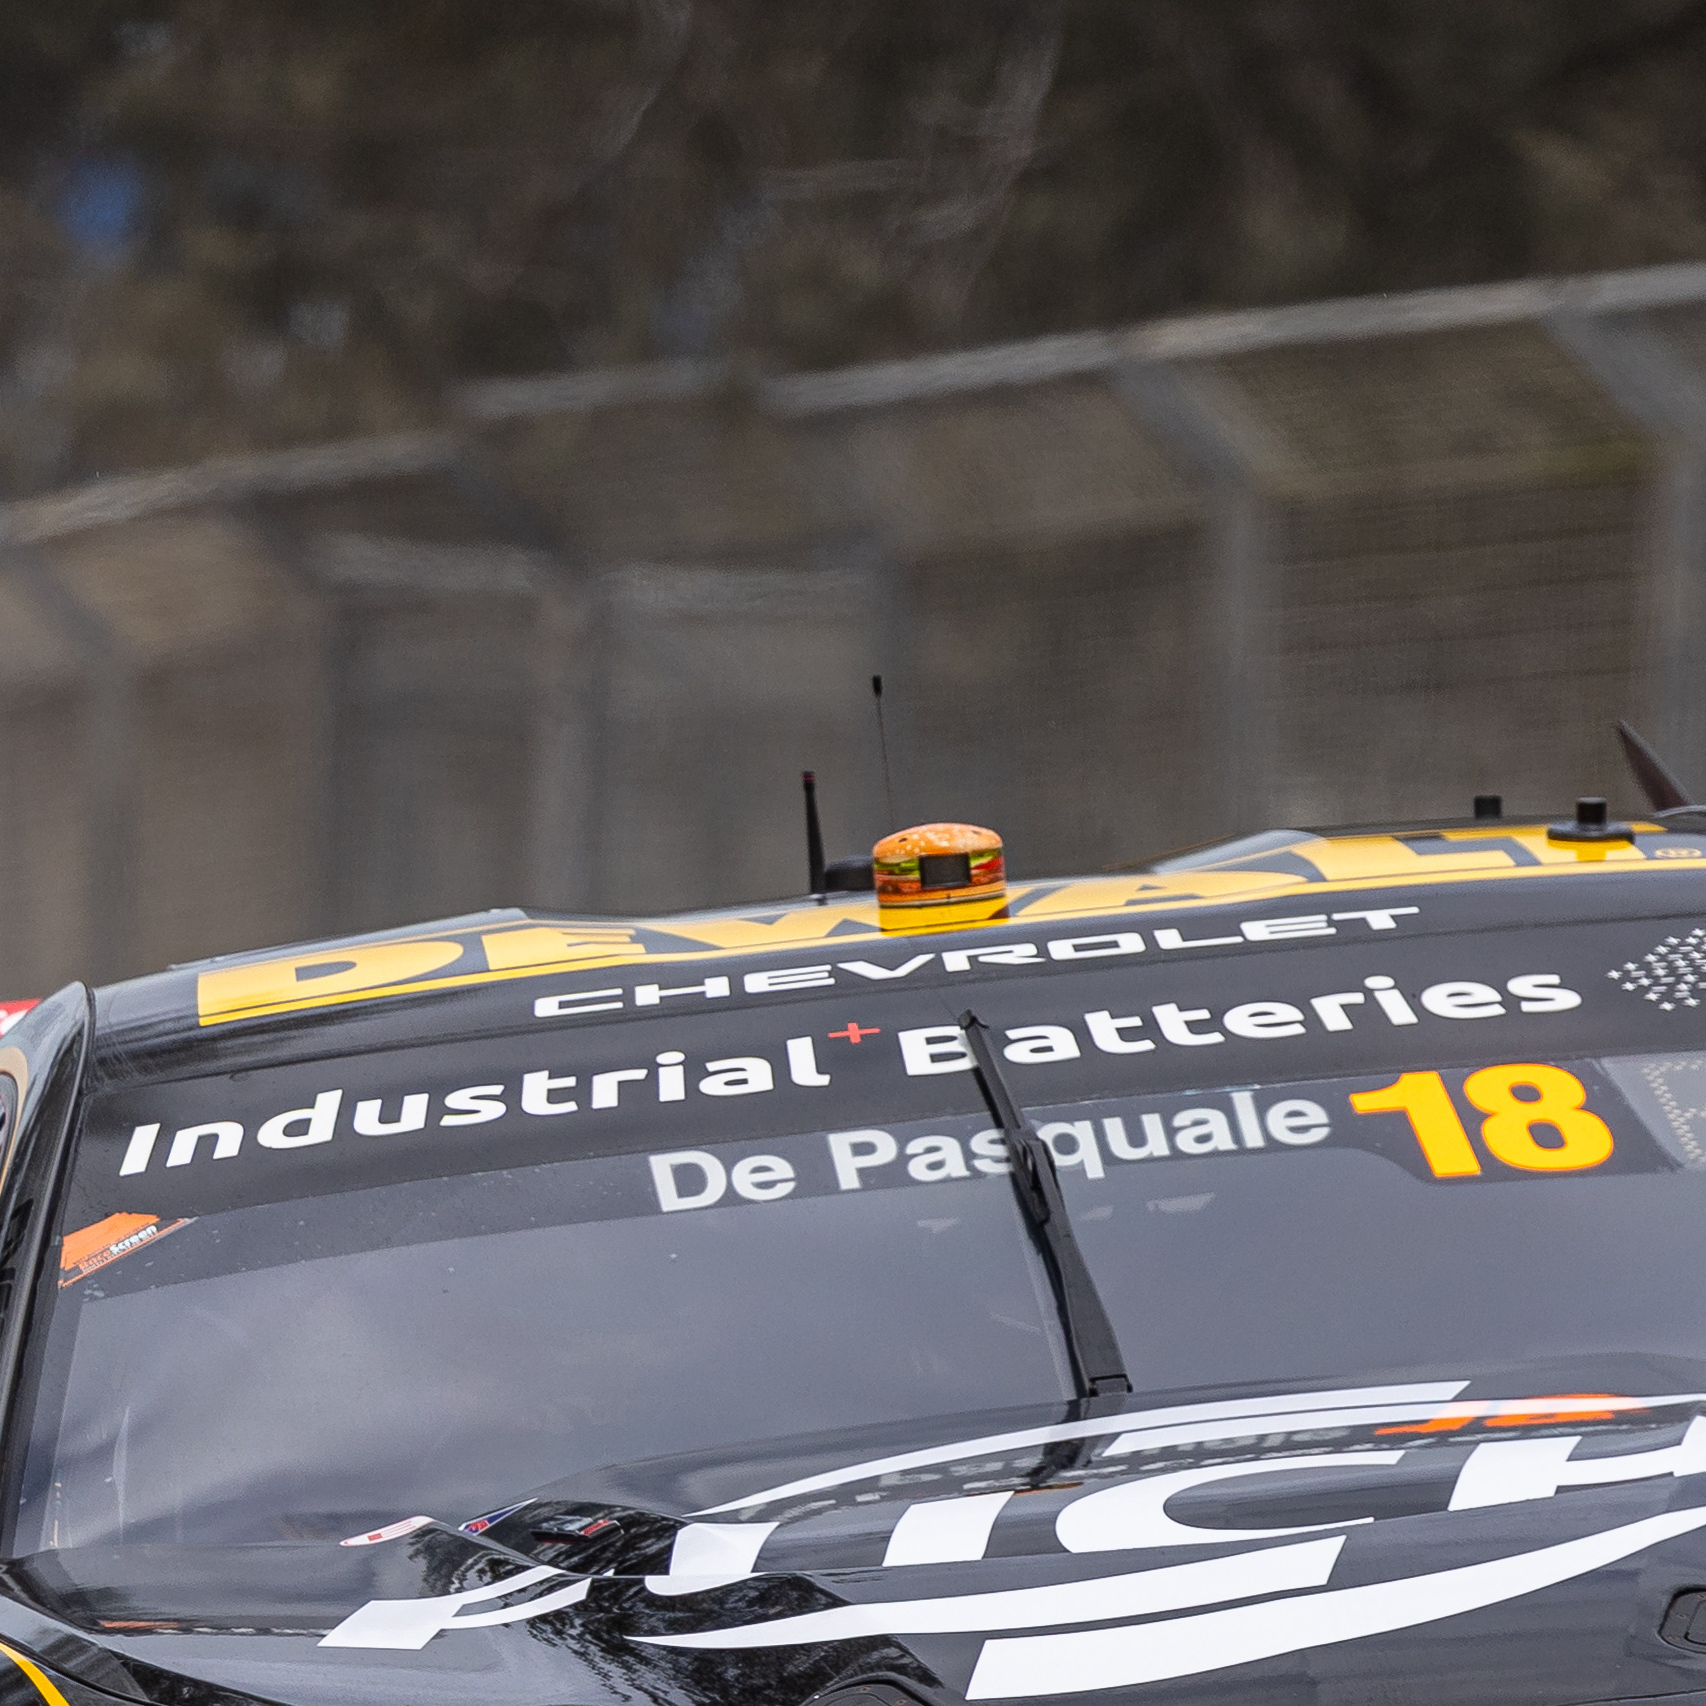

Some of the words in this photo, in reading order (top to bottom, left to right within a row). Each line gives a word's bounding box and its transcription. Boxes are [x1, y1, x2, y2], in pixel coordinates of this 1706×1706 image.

[534, 905, 1419, 1018] CHEVROLET
[896, 971, 1584, 1078] Batteries
[649, 1149, 797, 1214] De
[827, 1088, 1332, 1191] Pasquale
[1349, 1063, 1615, 1179] 18
